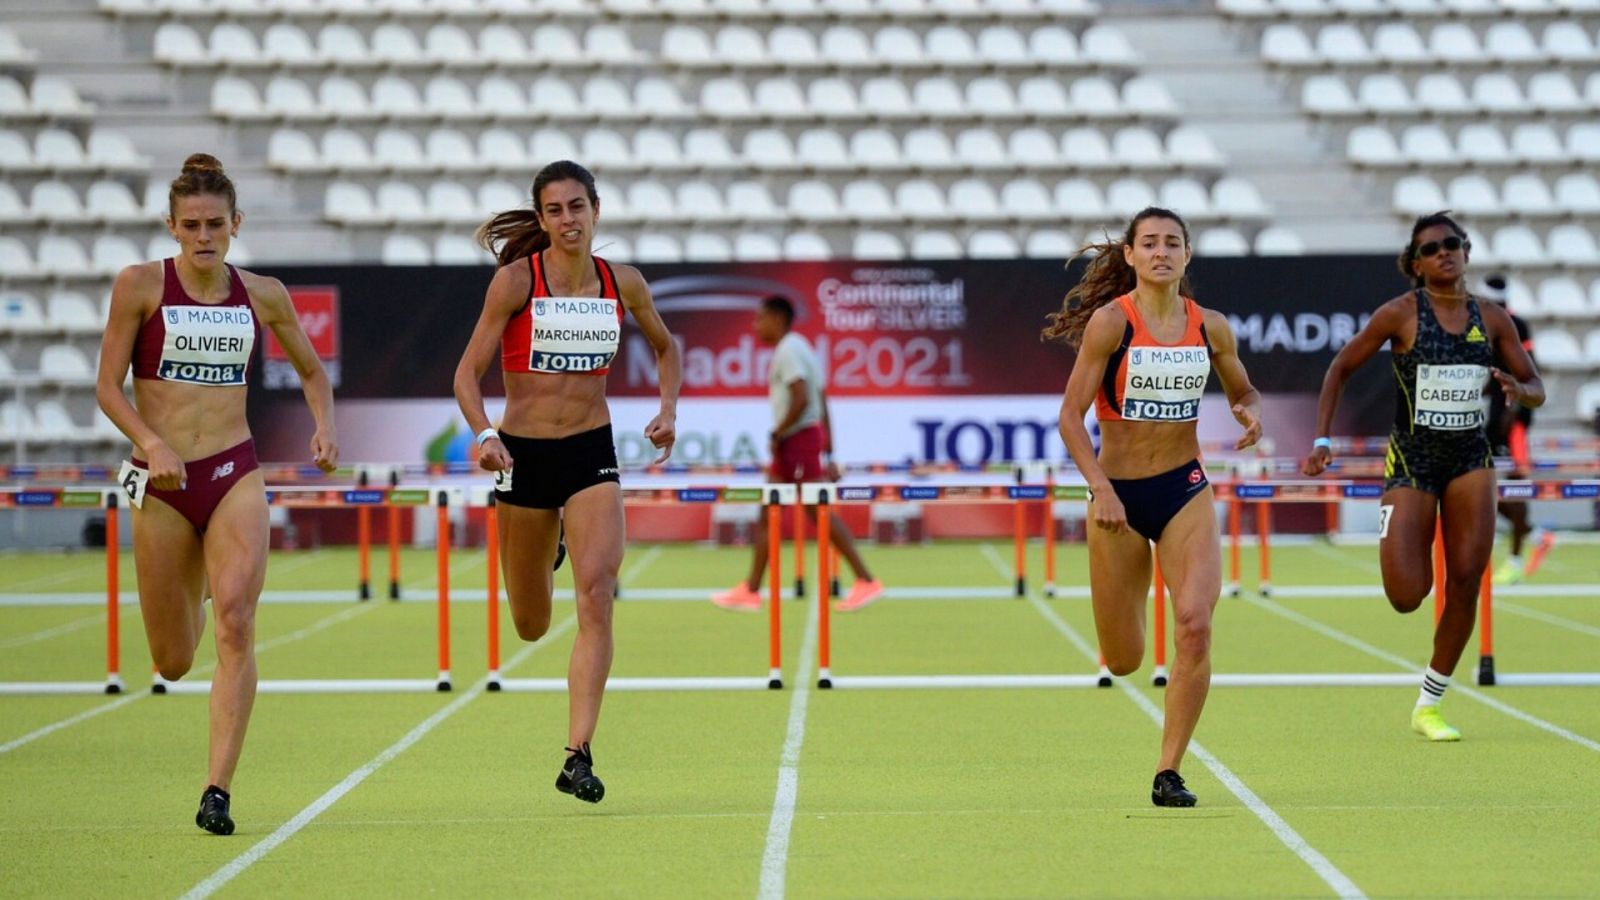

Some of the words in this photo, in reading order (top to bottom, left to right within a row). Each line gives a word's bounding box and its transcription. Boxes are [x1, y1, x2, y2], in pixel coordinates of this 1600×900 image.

[817, 279, 964, 306] Continental
[188, 310, 250, 325] MADRID
[555, 302, 614, 315] MADRID
[824, 306, 876, 330] Tour
[534, 328, 617, 341] MARCHIANDO
[1229, 314, 1391, 352] MADR
[175, 335, 243, 352] OLIVIERI
[627, 335, 829, 388] Madr
[833, 337, 972, 388] 2021
[1152, 351, 1205, 364] MADRID
[1131, 375, 1204, 390] GALLEGO
[907, 420, 1101, 470] Jom
[123, 469, 138, 499] 6
